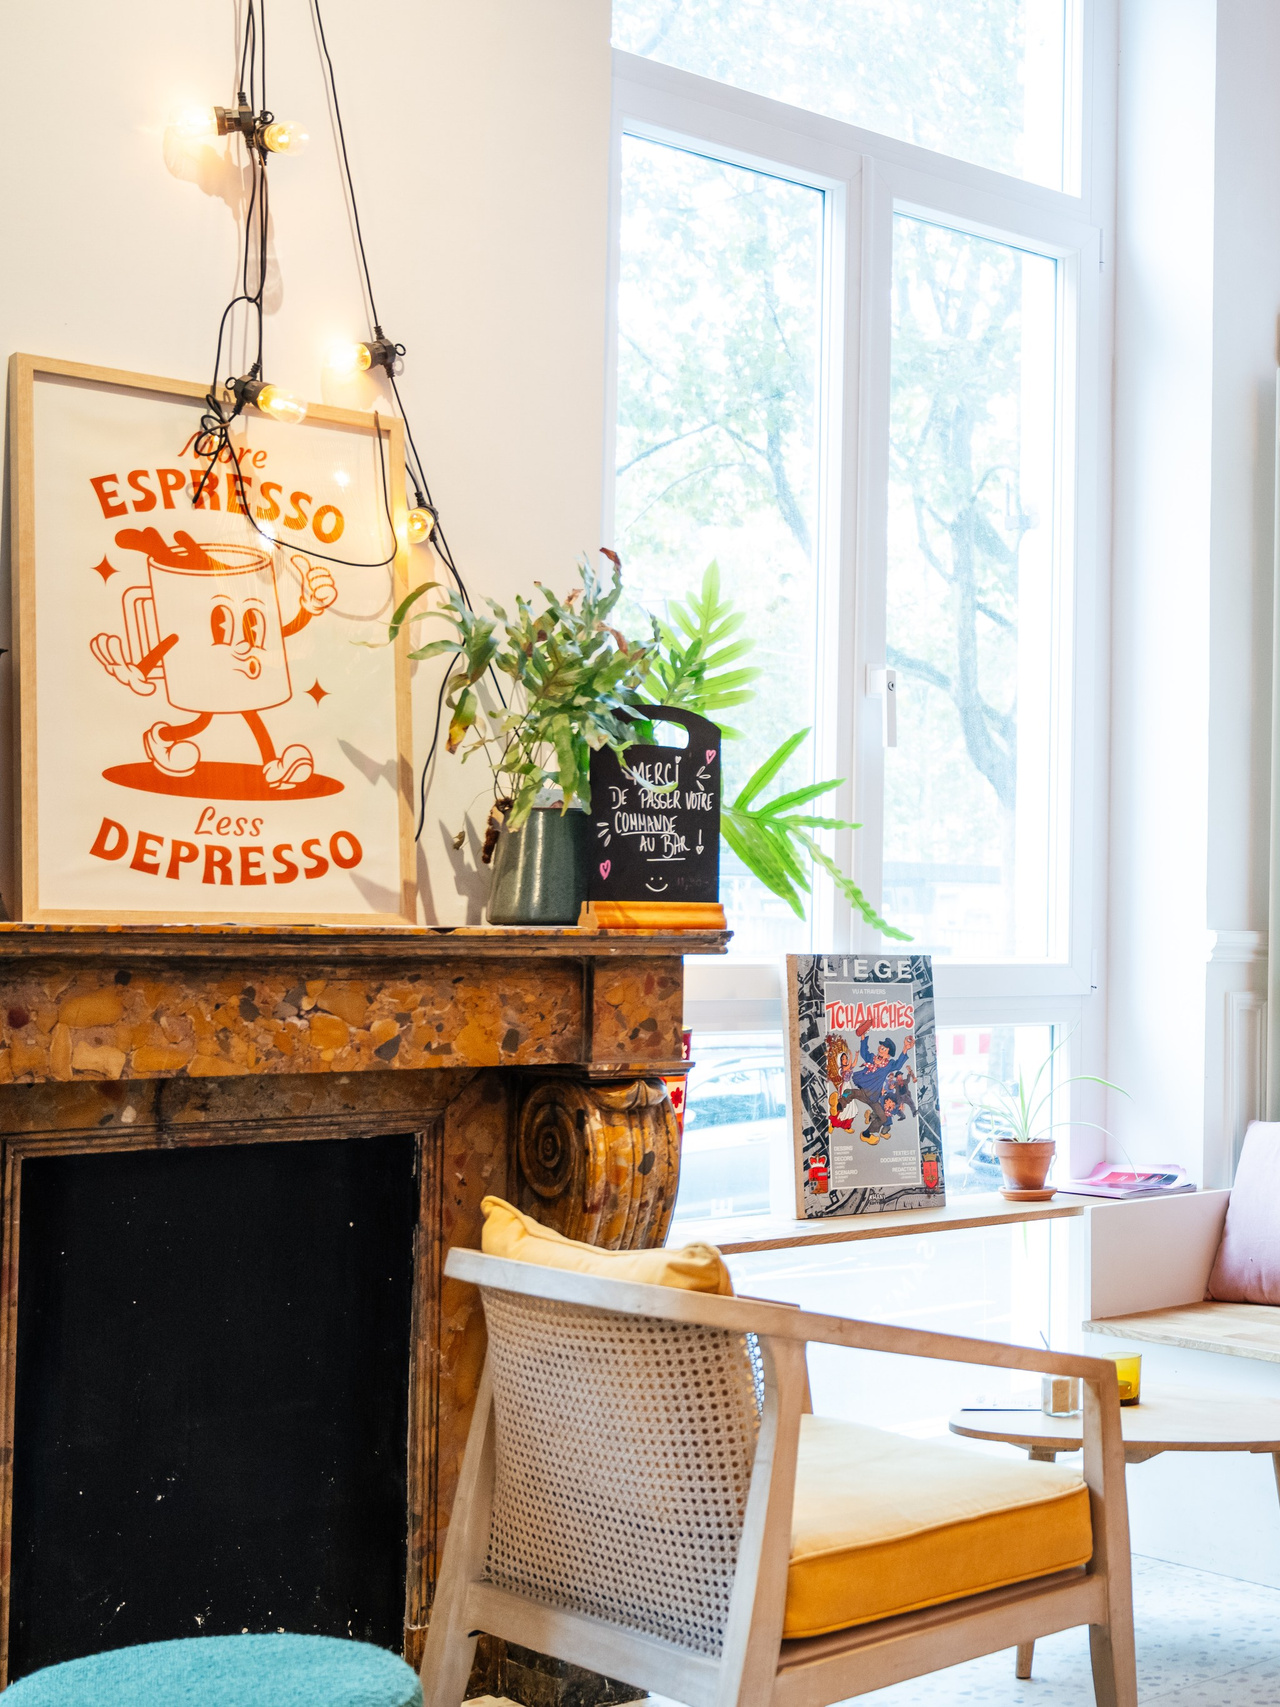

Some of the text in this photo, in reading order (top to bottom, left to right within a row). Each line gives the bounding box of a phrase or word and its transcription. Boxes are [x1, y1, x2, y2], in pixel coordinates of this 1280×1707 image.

[178, 431, 268, 469] More
[89, 468, 345, 544] ESPRESSO
[608, 786, 714, 811] DE PASSER VOTRE
[194, 806, 264, 837] Less
[614, 811, 678, 834] COMMANDE
[89, 817, 363, 886] DEPRESSO
[639, 835, 656, 853] AU
[660, 833, 691, 859] BAR
[823, 958, 912, 979] LIEGE
[825, 1000, 914, 1031] TCHANTCHÈS
